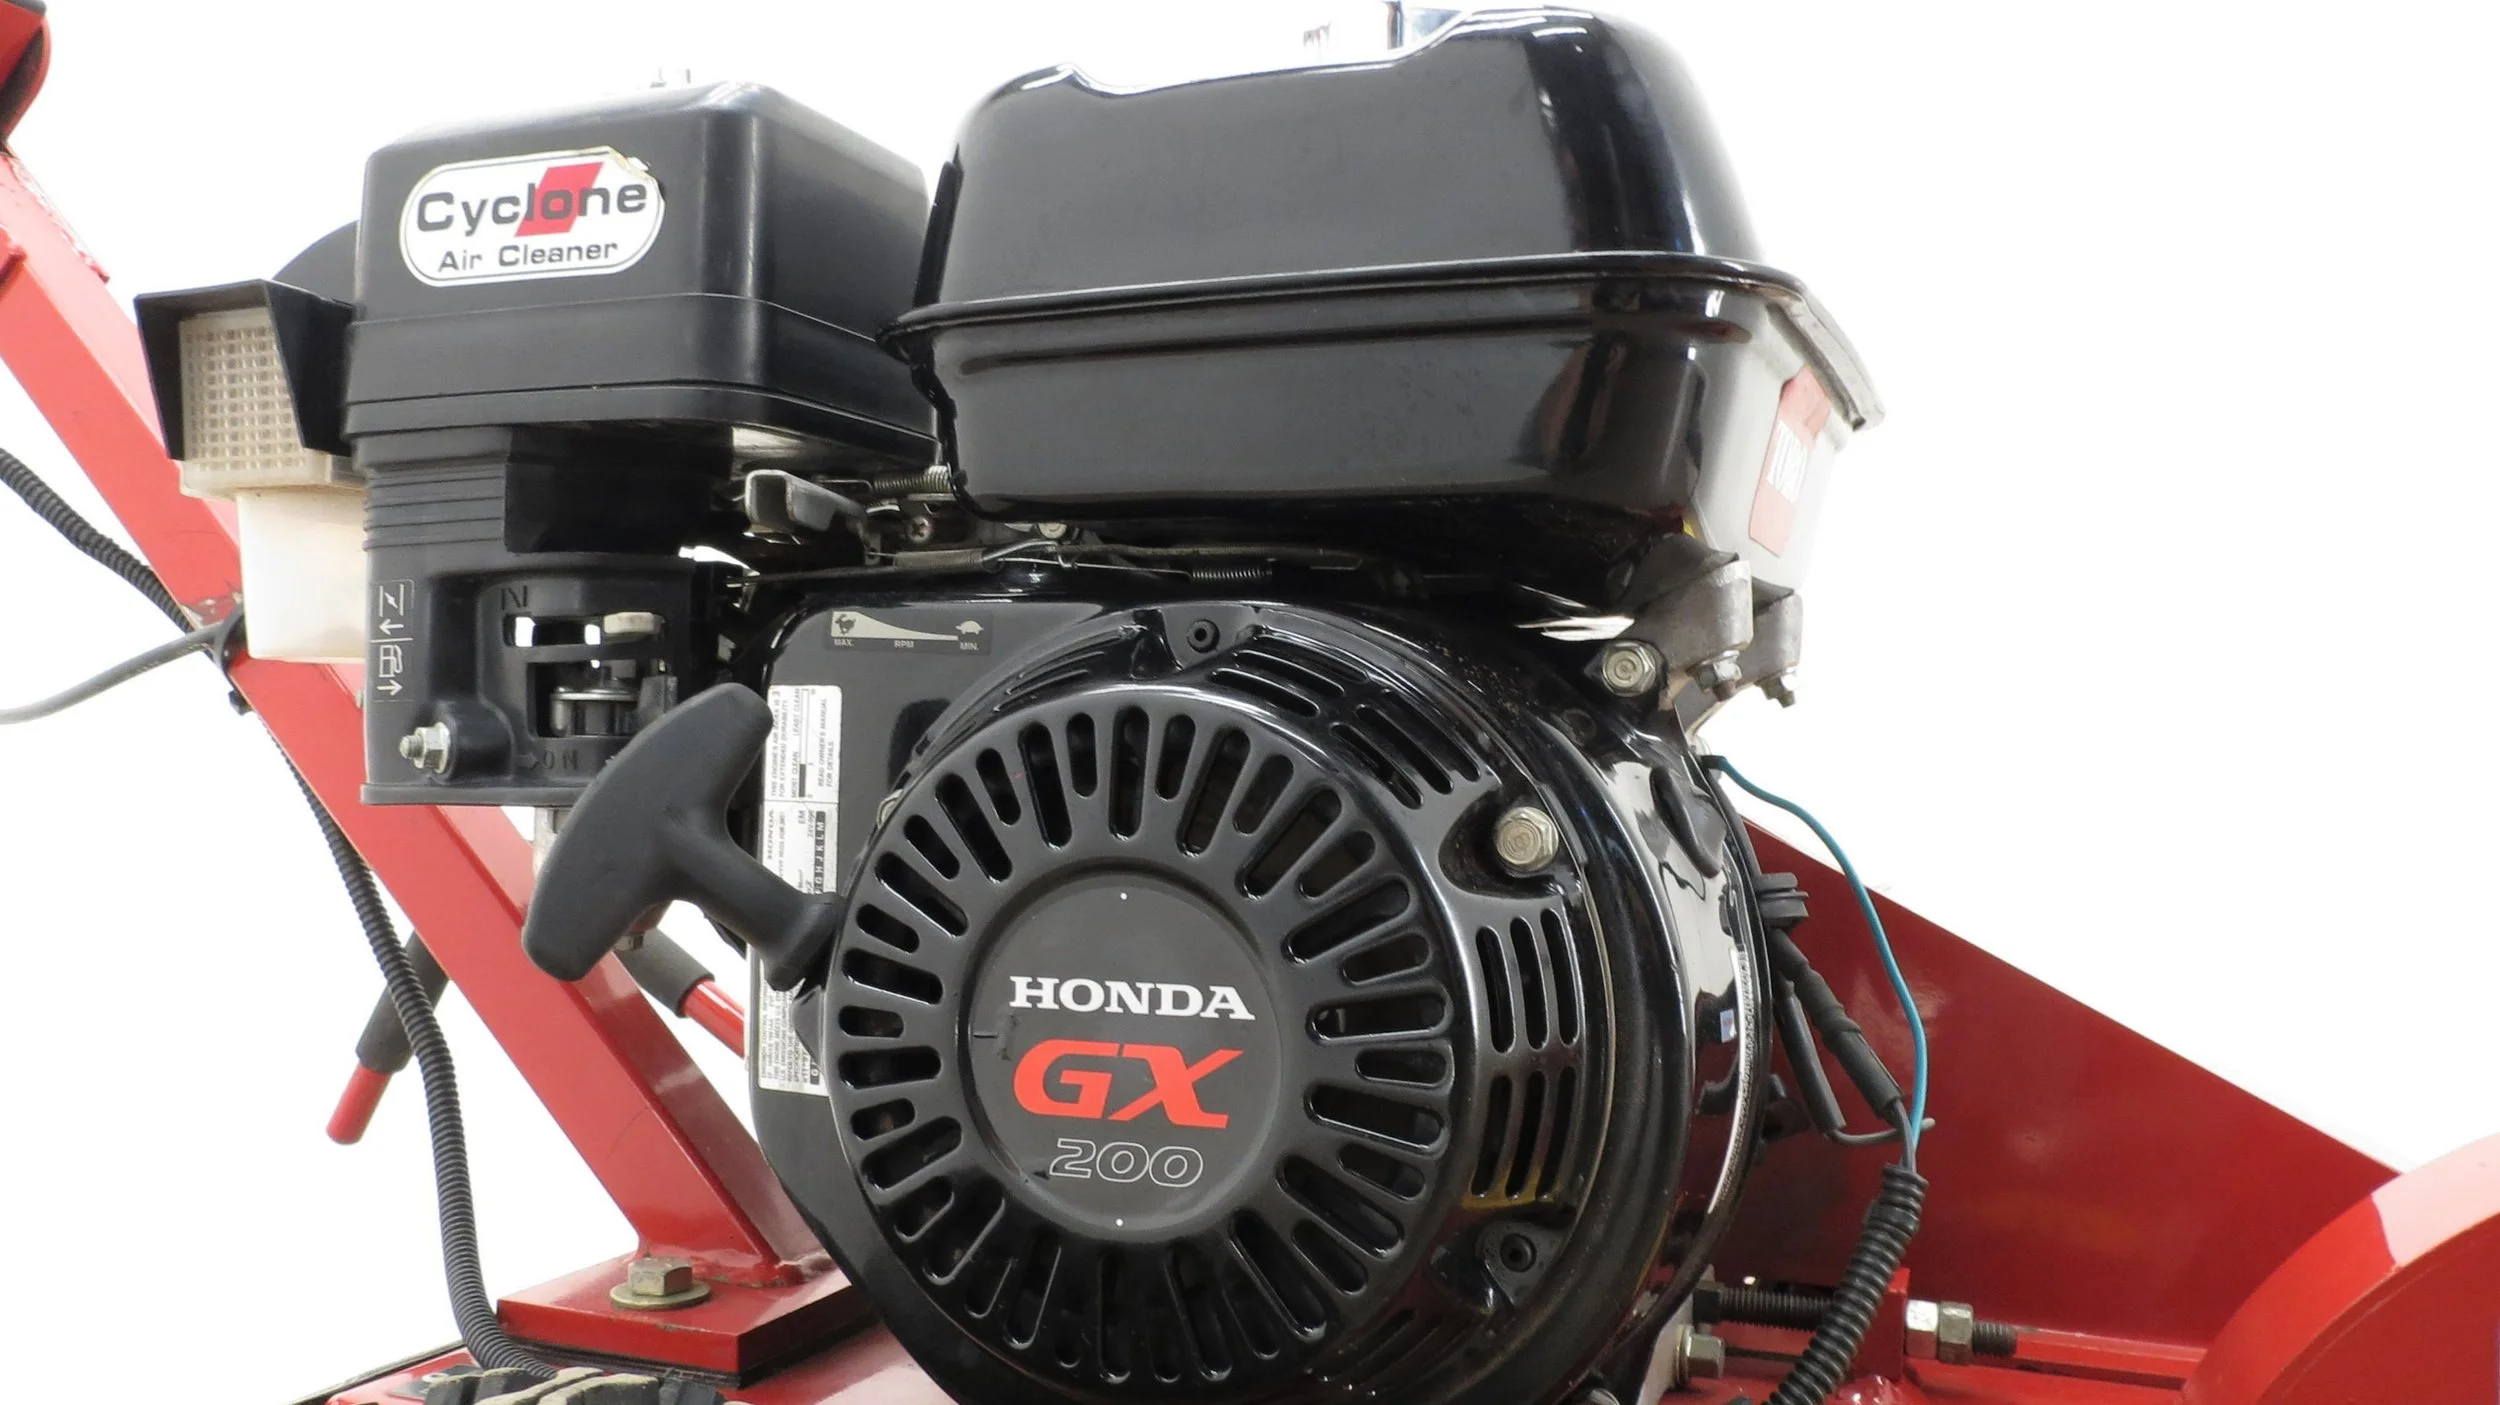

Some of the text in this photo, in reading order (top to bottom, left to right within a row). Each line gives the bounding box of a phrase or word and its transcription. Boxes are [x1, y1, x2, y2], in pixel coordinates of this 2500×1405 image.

[417, 183, 647, 237] Cyclone
[439, 242, 618, 272] Air Cleaner
[894, 640, 914, 648] RPM
[1009, 976, 1256, 1020] HONDA
[1013, 1039, 1244, 1129] GX
[1050, 1138, 1203, 1187] 200
